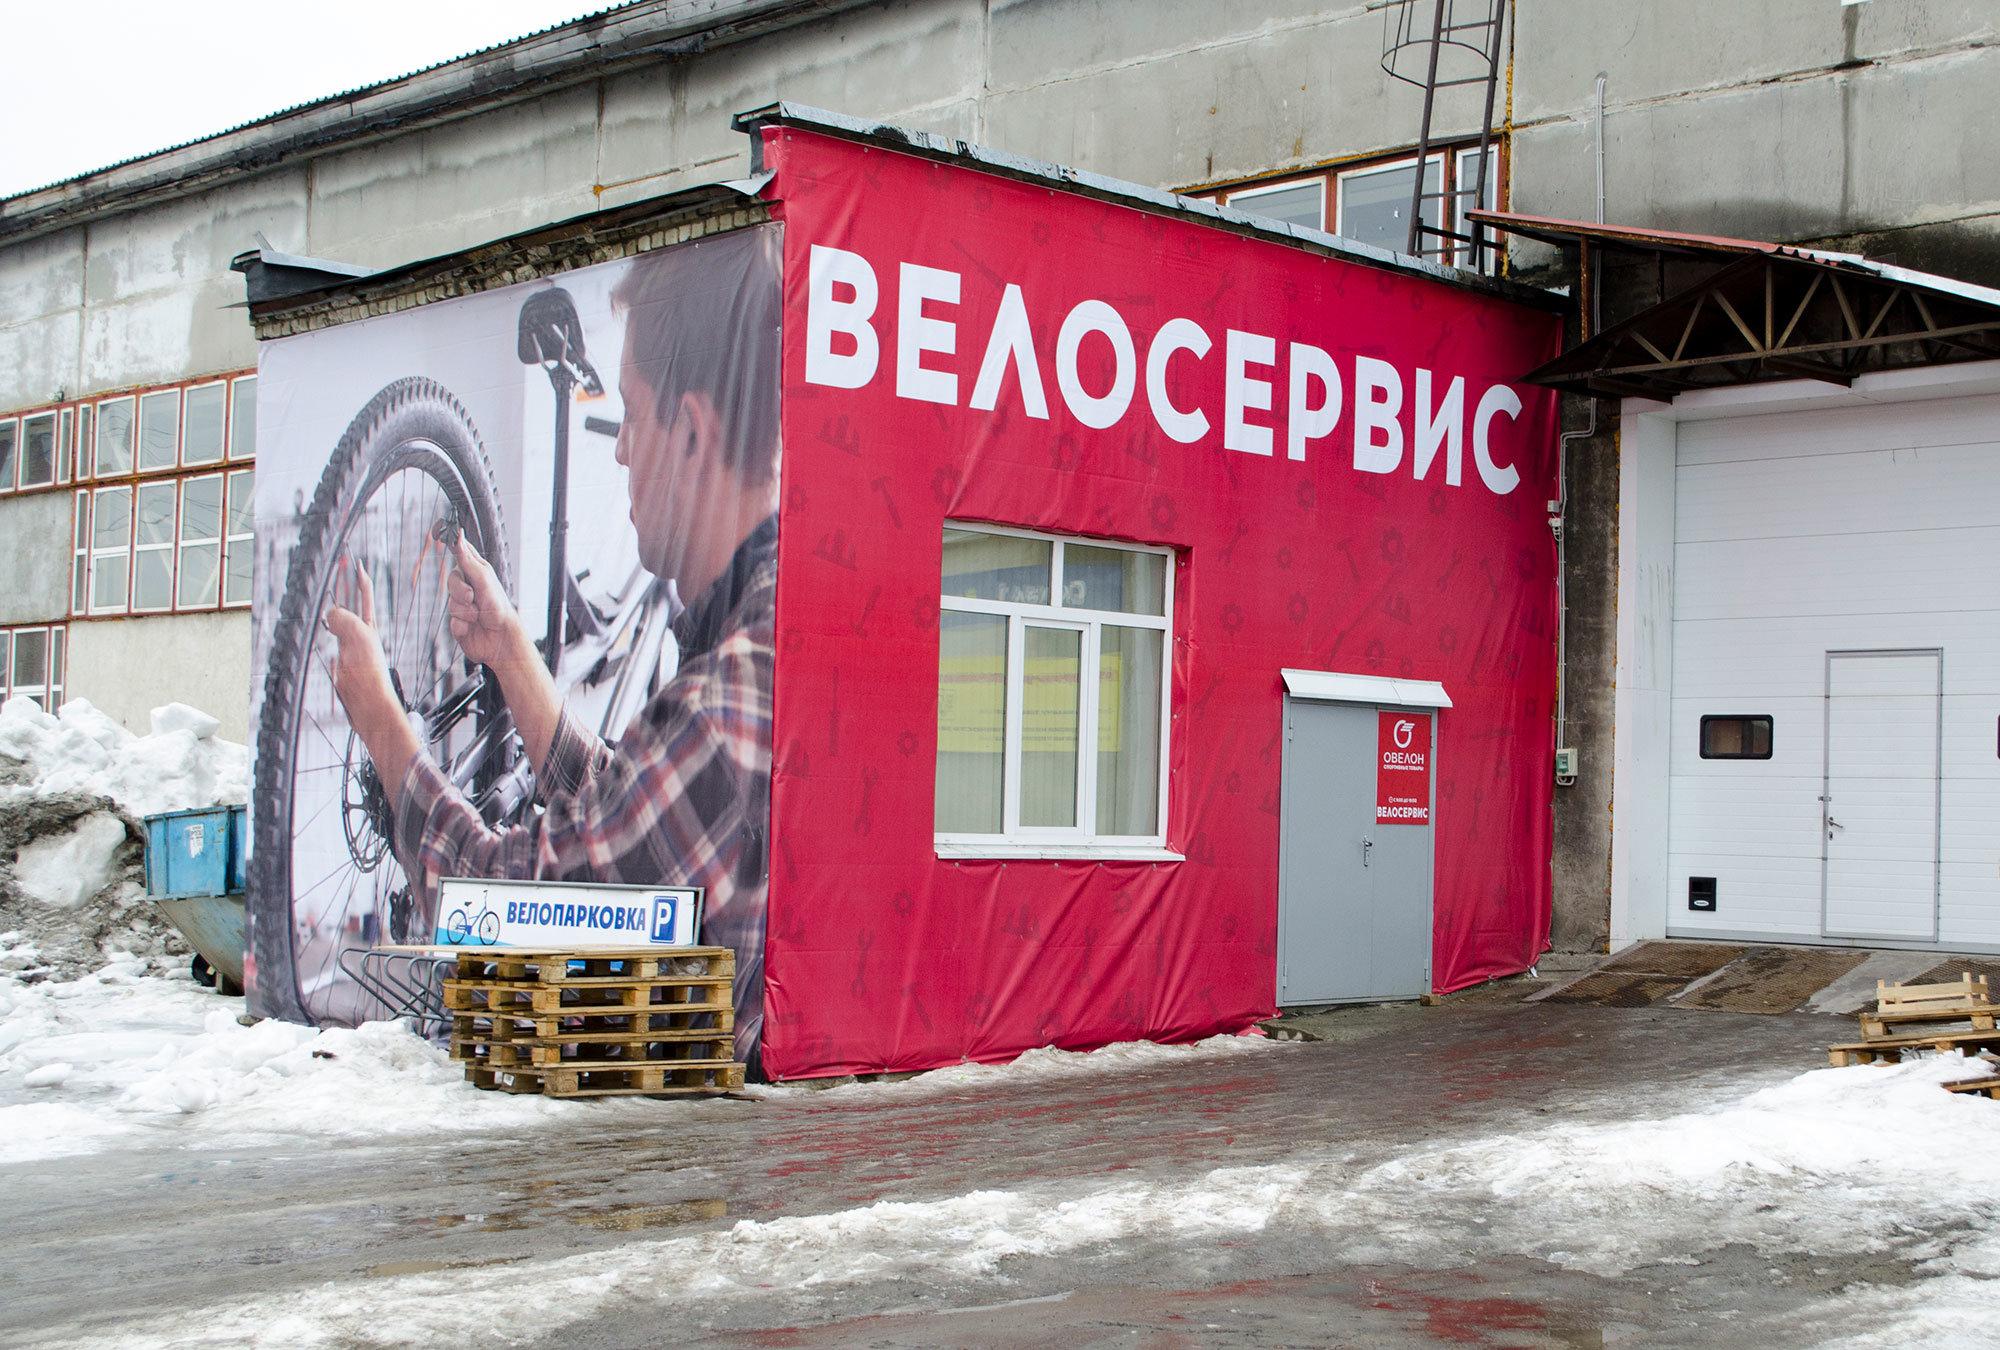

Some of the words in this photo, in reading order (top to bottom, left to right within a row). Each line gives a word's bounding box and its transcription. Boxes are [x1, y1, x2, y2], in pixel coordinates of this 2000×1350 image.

[804, 242, 1523, 495] ВЕЛОСЕРВИС
[1383, 751, 1425, 765] ОВЕЛОН
[1377, 806, 1428, 819] ВЕЛОСЕРВИС
[506, 901, 646, 931] ВЕЛОПАРКОВКА
